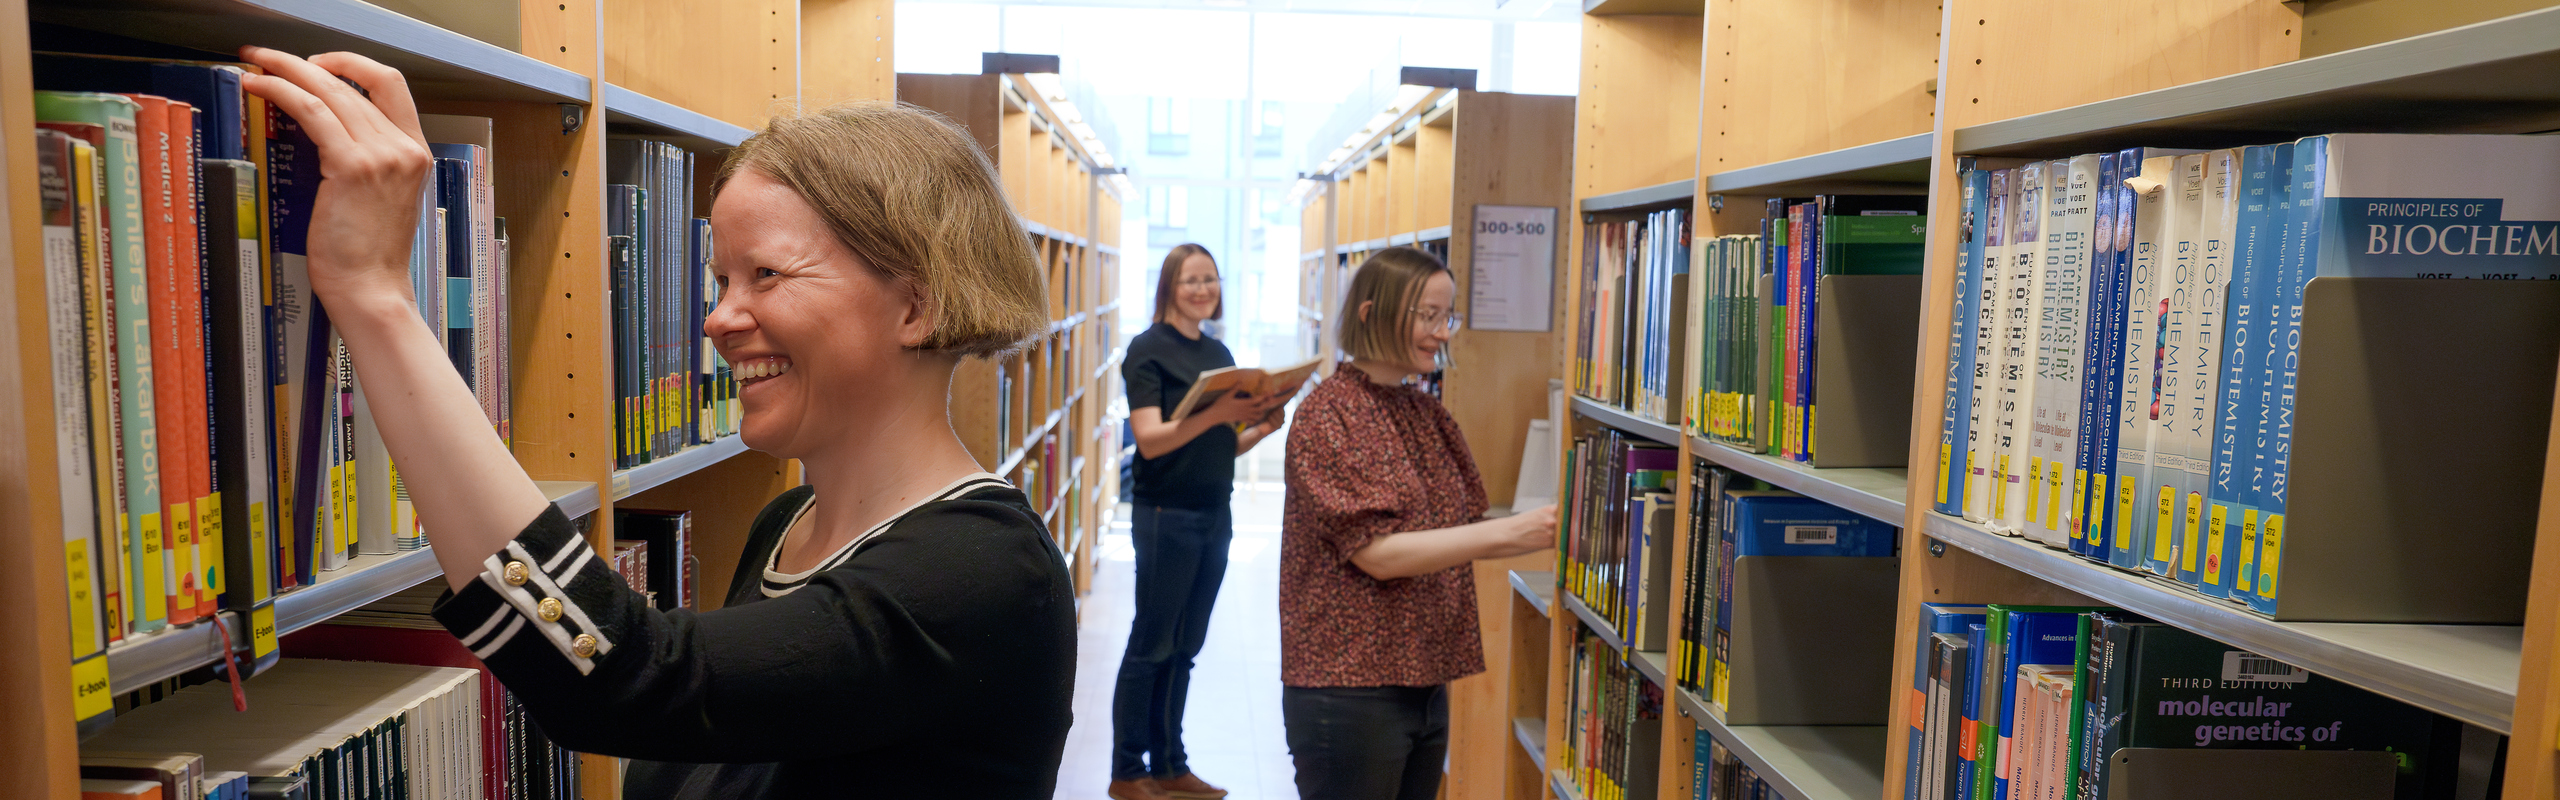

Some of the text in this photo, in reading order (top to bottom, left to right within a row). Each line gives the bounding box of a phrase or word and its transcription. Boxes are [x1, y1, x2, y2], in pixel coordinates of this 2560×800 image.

[159, 131, 174, 223] Medicin 2
[185, 136, 197, 225] Medicin 2
[2252, 171, 2266, 179] VOET
[2069, 194, 2087, 202] VOET
[2186, 193, 2199, 202] Pratt
[2251, 187, 2264, 196] VOET
[195, 128, 210, 291] Improving Patient Care
[2067, 207, 2088, 215] PRATT
[2247, 204, 2263, 212] PRATT
[2367, 203, 2485, 218] PRINCIPLES OF
[122, 139, 146, 306] Bonniers
[1478, 221, 1546, 235] 300-500
[2364, 223, 2560, 256] BIOCHEM
[1802, 241, 1810, 263] CELL
[2187, 242, 2199, 299] Principles
[2217, 240, 2228, 300] Principles
[1983, 256, 2000, 378] FUNDAMENTALS OF
[2018, 252, 2034, 380] FUNDAMENTALS OF
[2037, 233, 2061, 380] BIOCHEMISTRY
[2055, 232, 2079, 382] BIOCHEMISTRY
[2069, 232, 2085, 382] FUNDAMENTALS OF
[1799, 303, 1807, 348] Problems
[2090, 264, 2106, 375] FUNDAMENTALS
[2109, 263, 2125, 376] FUNDAMENTALS
[2124, 242, 2150, 429] BIOCHEMISTRY
[2162, 241, 2190, 433] BIOCHEMISTRY
[2191, 240, 2219, 438] BIOCHEMISTRY
[2218, 225, 2256, 492] PRINCIPLES OF BIOCHEMISTRY
[2271, 221, 2308, 504] PRINCIPLES OF BIOCHEMISTRY
[2089, 380, 2095, 398] OF
[2108, 381, 2114, 399] OF
[2118, 450, 2145, 461] Third Edition
[2155, 455, 2166, 464] Third
[2121, 487, 2130, 495] 572
[2160, 498, 2170, 507] 572
[2160, 508, 2169, 516] Voe
[2187, 507, 2196, 515] 572
[2186, 517, 2195, 525] Voe
[2210, 528, 2219, 536] Voe
[2211, 518, 2220, 526] 572
[2244, 523, 2256, 531] 572
[2243, 533, 2255, 542] Voe
[2264, 538, 2275, 547] Voe
[2265, 528, 2276, 537] 572
[255, 624, 274, 640] E-book
[2041, 634, 2074, 642] Advances in
[2102, 640, 2111, 684] Champness
[78, 678, 108, 699] E-book
[2161, 677, 2293, 690] THIRD EDITION
[2158, 695, 2292, 717] molecular
[520, 711, 528, 771] Medicinsk
[2083, 705, 2095, 768] 4TH EDITION
[2095, 695, 2108, 781] molecular
[2195, 720, 2342, 746] genetics of
[508, 720, 516, 780] Medicinsk
[1957, 762, 1966, 792] Oxygen
